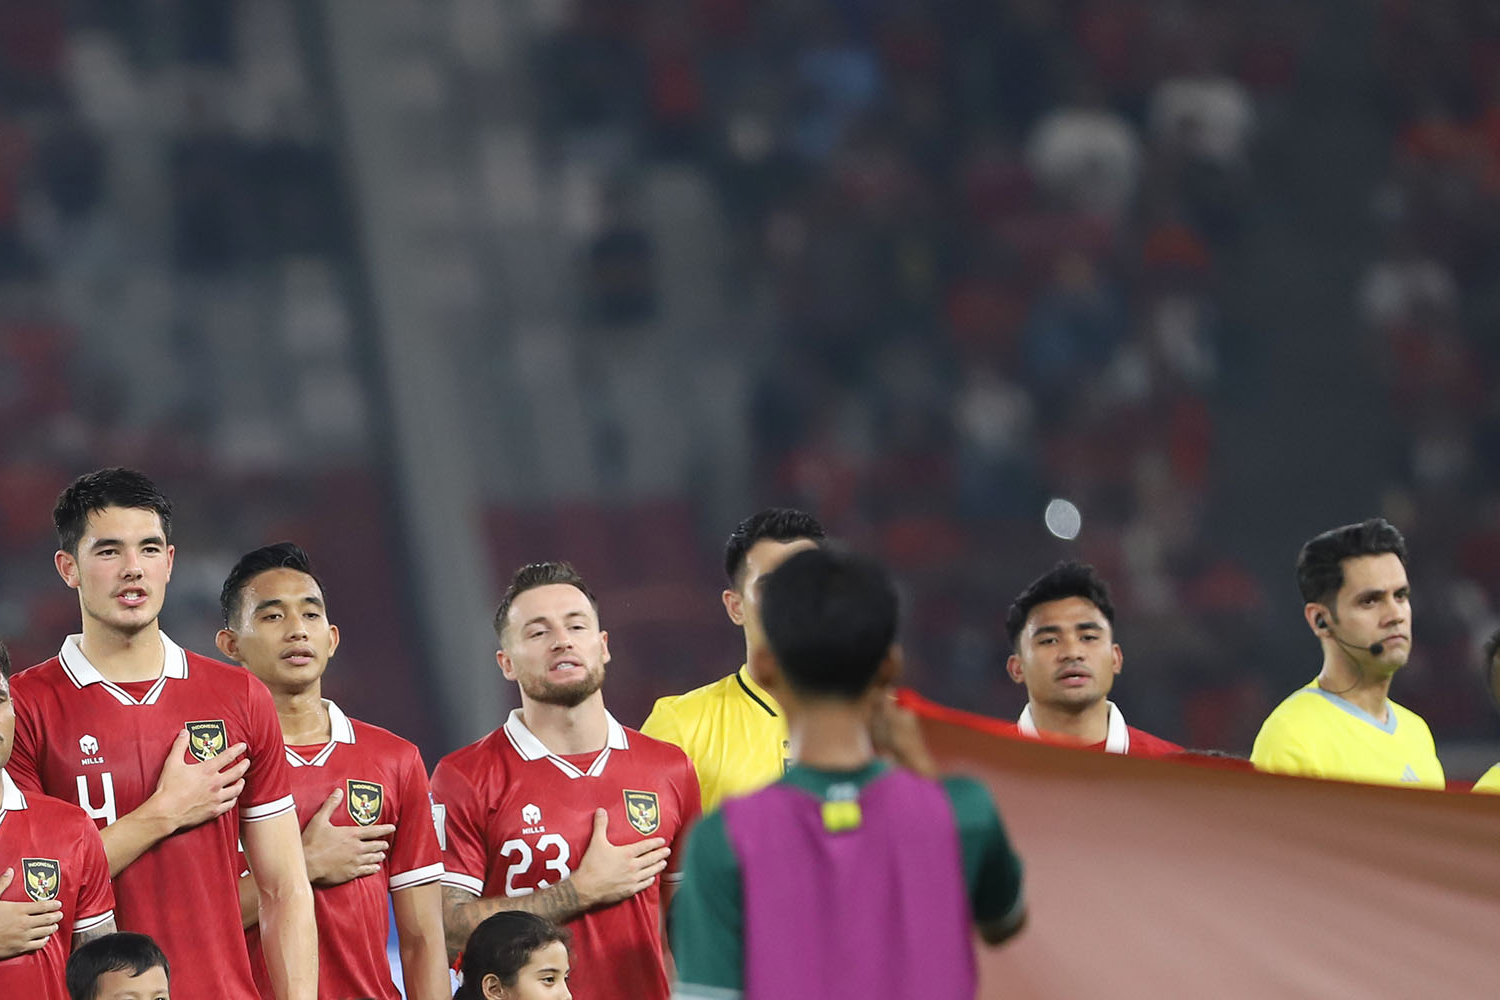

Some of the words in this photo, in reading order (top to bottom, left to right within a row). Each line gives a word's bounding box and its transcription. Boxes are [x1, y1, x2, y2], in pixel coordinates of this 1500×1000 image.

[81, 756, 105, 766] MILLS
[76, 772, 117, 826] 4
[522, 825, 546, 835] MILLS
[500, 833, 571, 898] 23
